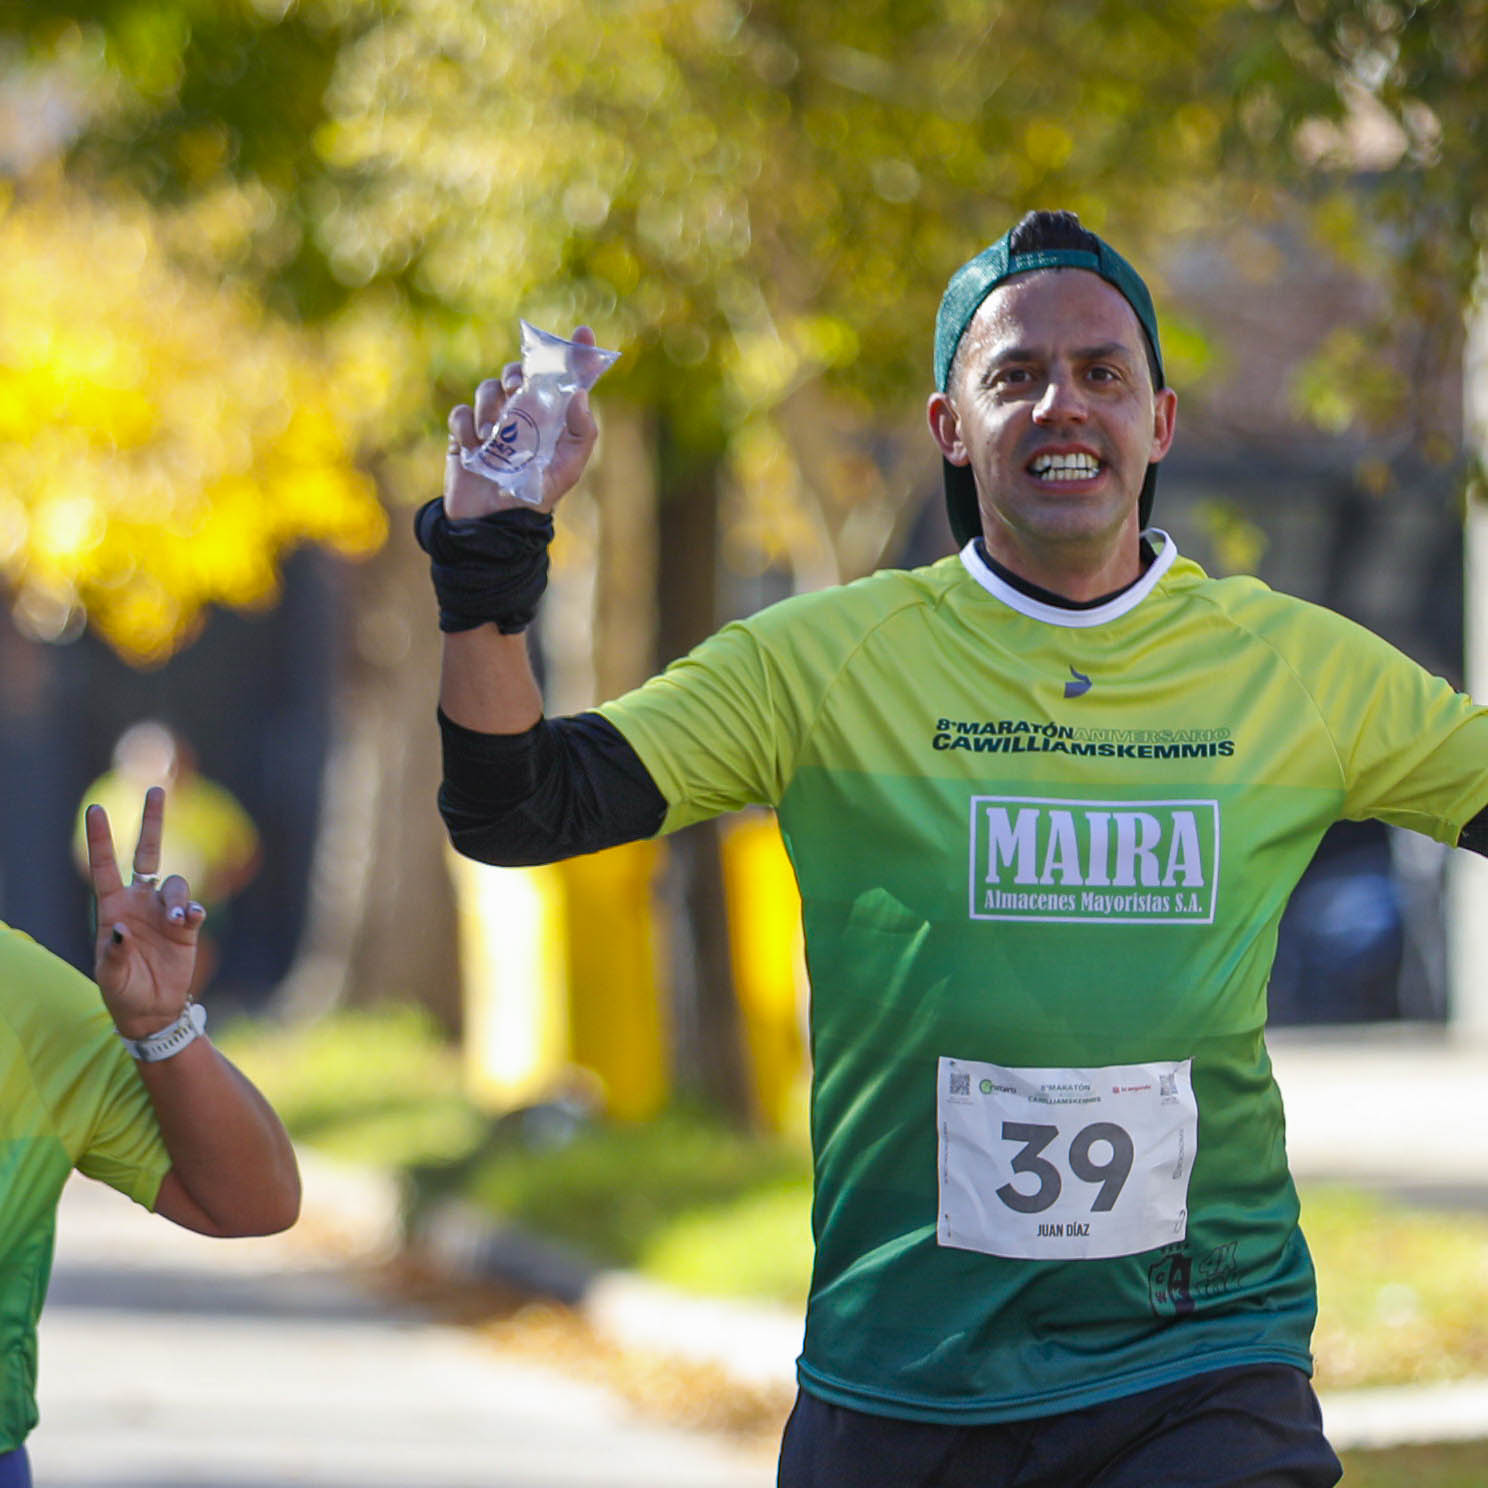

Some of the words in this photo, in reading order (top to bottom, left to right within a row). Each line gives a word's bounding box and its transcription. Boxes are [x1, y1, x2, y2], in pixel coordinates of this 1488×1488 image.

[932, 733, 1235, 759] CAWILLIAMSKEMMIS
[985, 807, 1205, 887] MAIRA
[984, 889, 1076, 911] Almacenes
[1080, 892, 1170, 914] Mayoristas
[1175, 893, 1203, 913] S.A.
[995, 1121, 1134, 1213] 39
[1037, 1223, 1064, 1237] JUAN
[1066, 1221, 1090, 1237] DÍAZ
